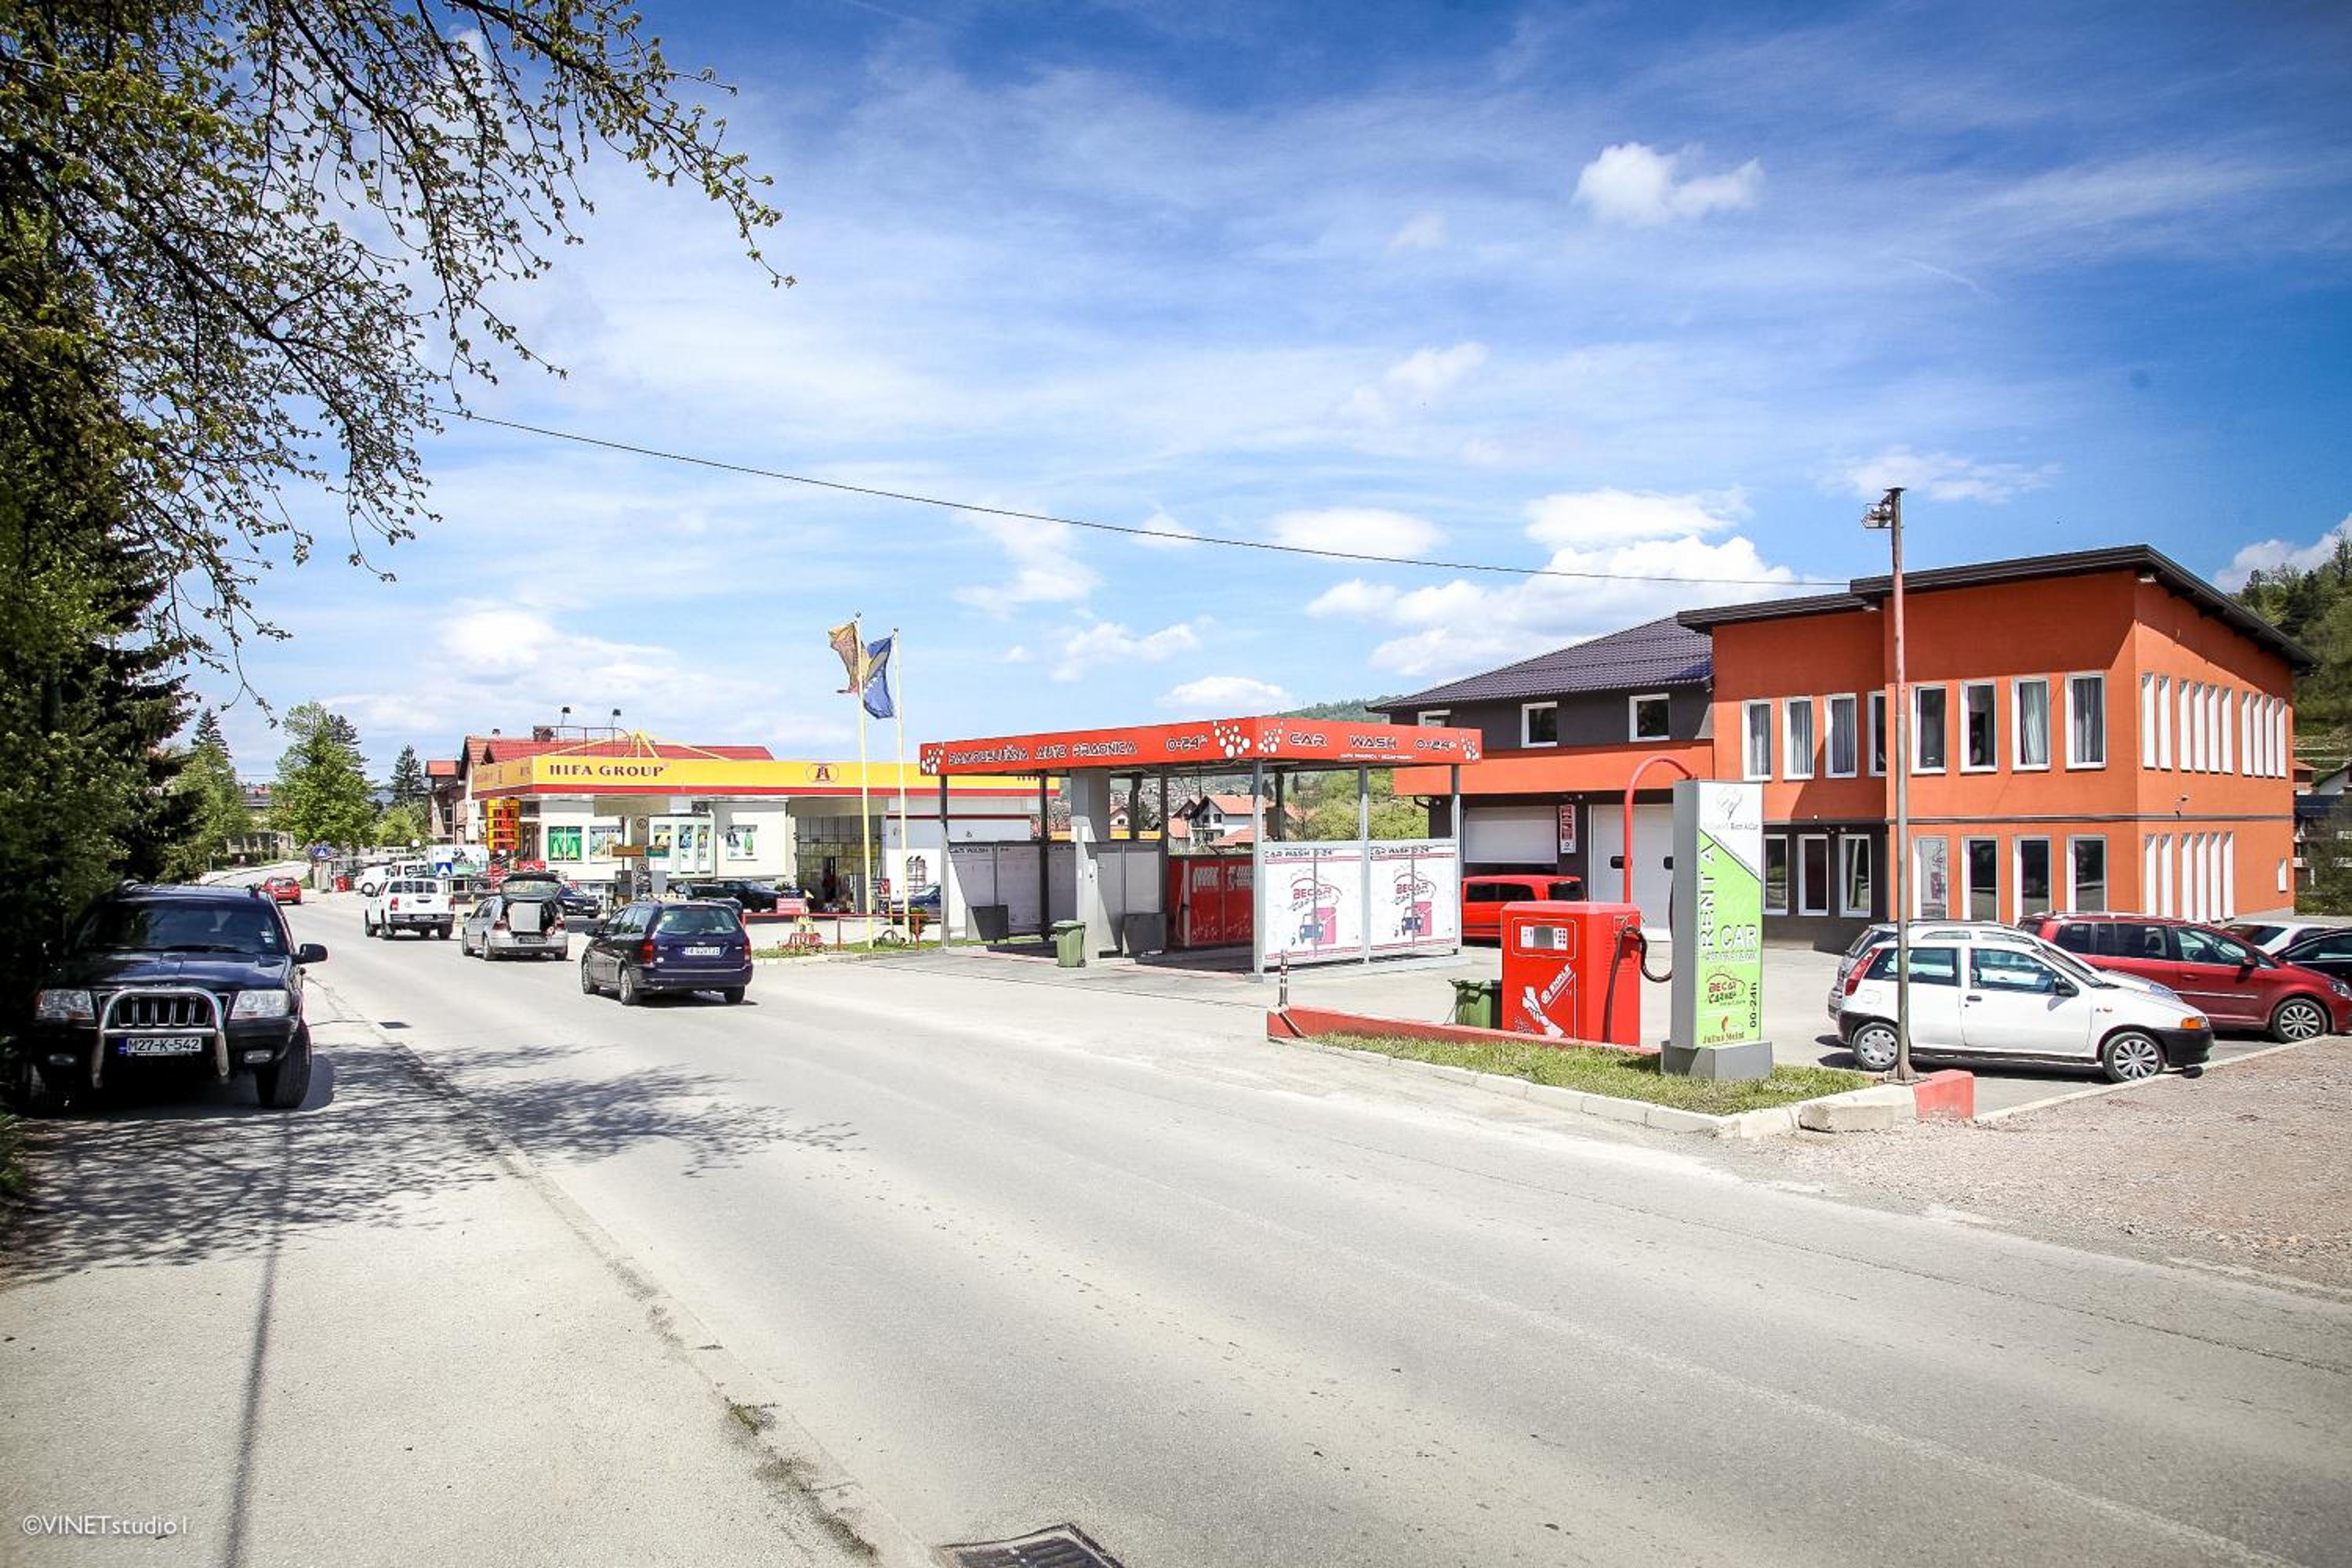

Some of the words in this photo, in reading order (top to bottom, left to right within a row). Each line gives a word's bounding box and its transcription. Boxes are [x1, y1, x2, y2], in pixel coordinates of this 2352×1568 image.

[1034, 744, 1068, 760] AUTO
[1072, 740, 1138, 757] PRAONICA
[1288, 731, 1328, 747] CAR
[1348, 735, 1397, 750] WASH
[549, 764, 593, 776] HIFA
[599, 764, 665, 778] GROUP
[1700, 843, 1715, 863] A
[1293, 886, 1332, 900] BECAR
[1700, 871, 1715, 947] RENT
[1720, 924, 1757, 949] CAR
[128, 1038, 200, 1051] M27-K-542
